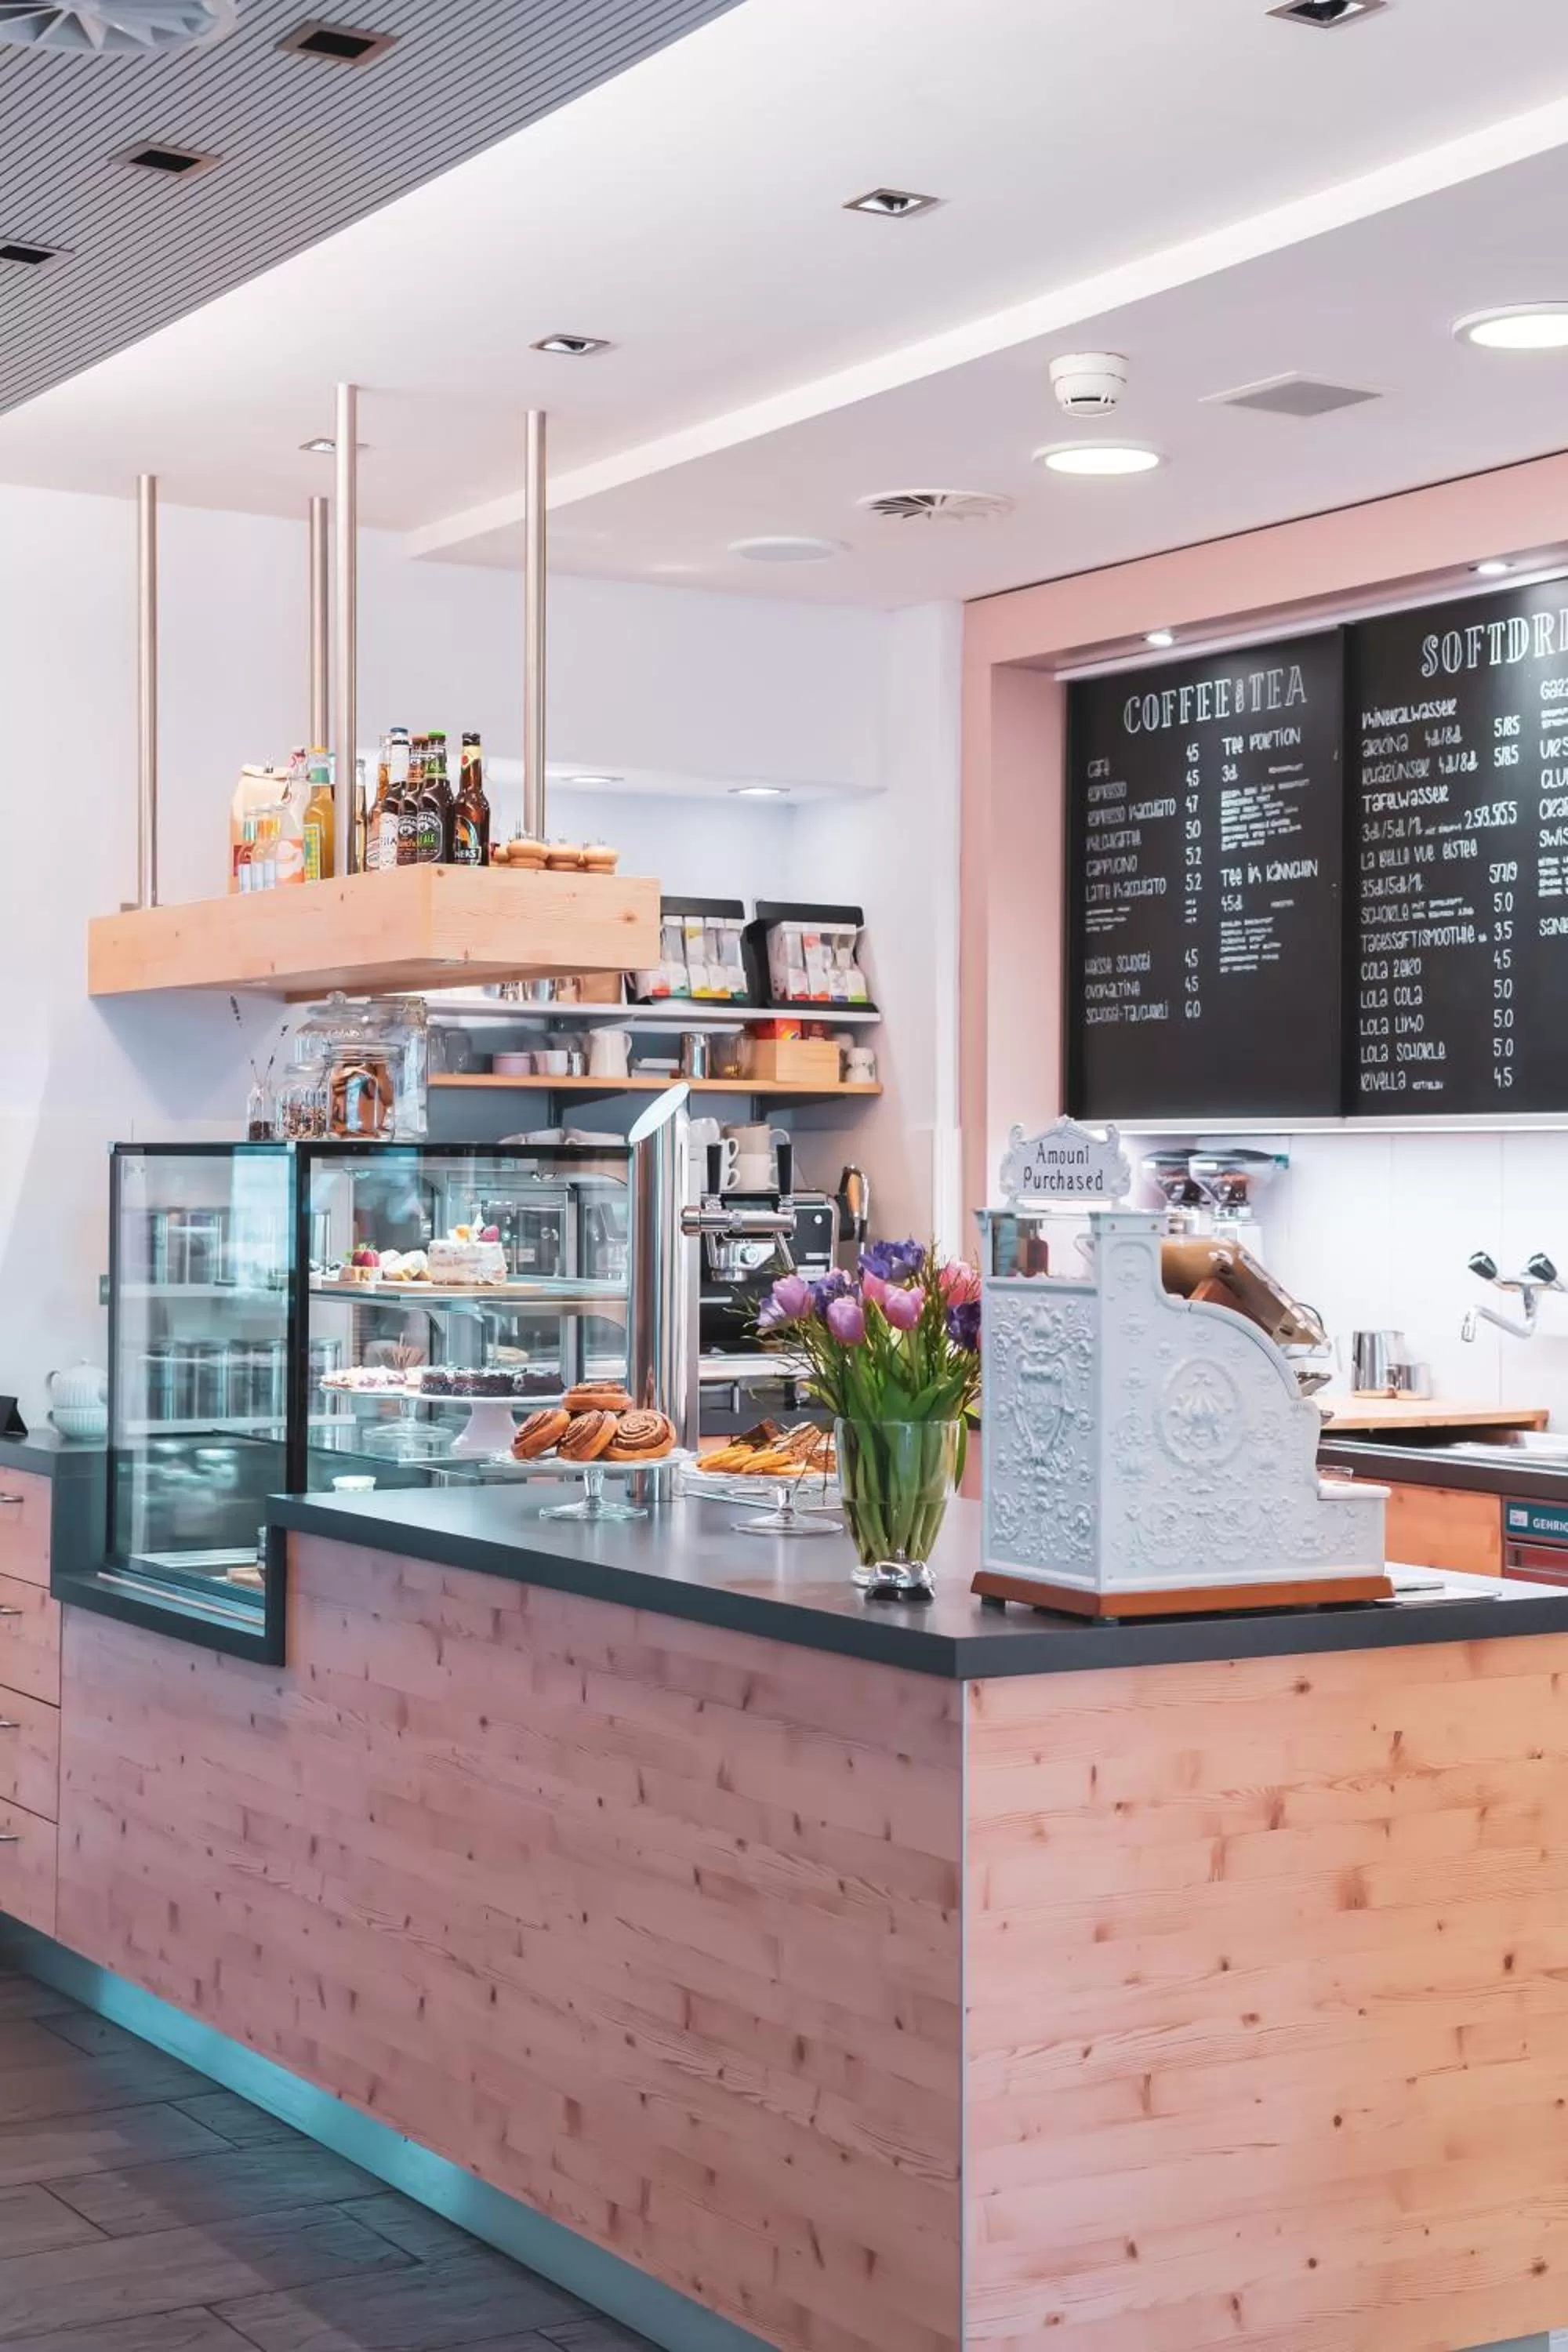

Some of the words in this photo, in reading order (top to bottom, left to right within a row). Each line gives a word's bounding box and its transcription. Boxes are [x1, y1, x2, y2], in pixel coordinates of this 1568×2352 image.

[1123, 678, 1232, 733] COFFEE
[1249, 665, 1308, 712] TEA
[1023, 1166, 1104, 1192] Purchased
